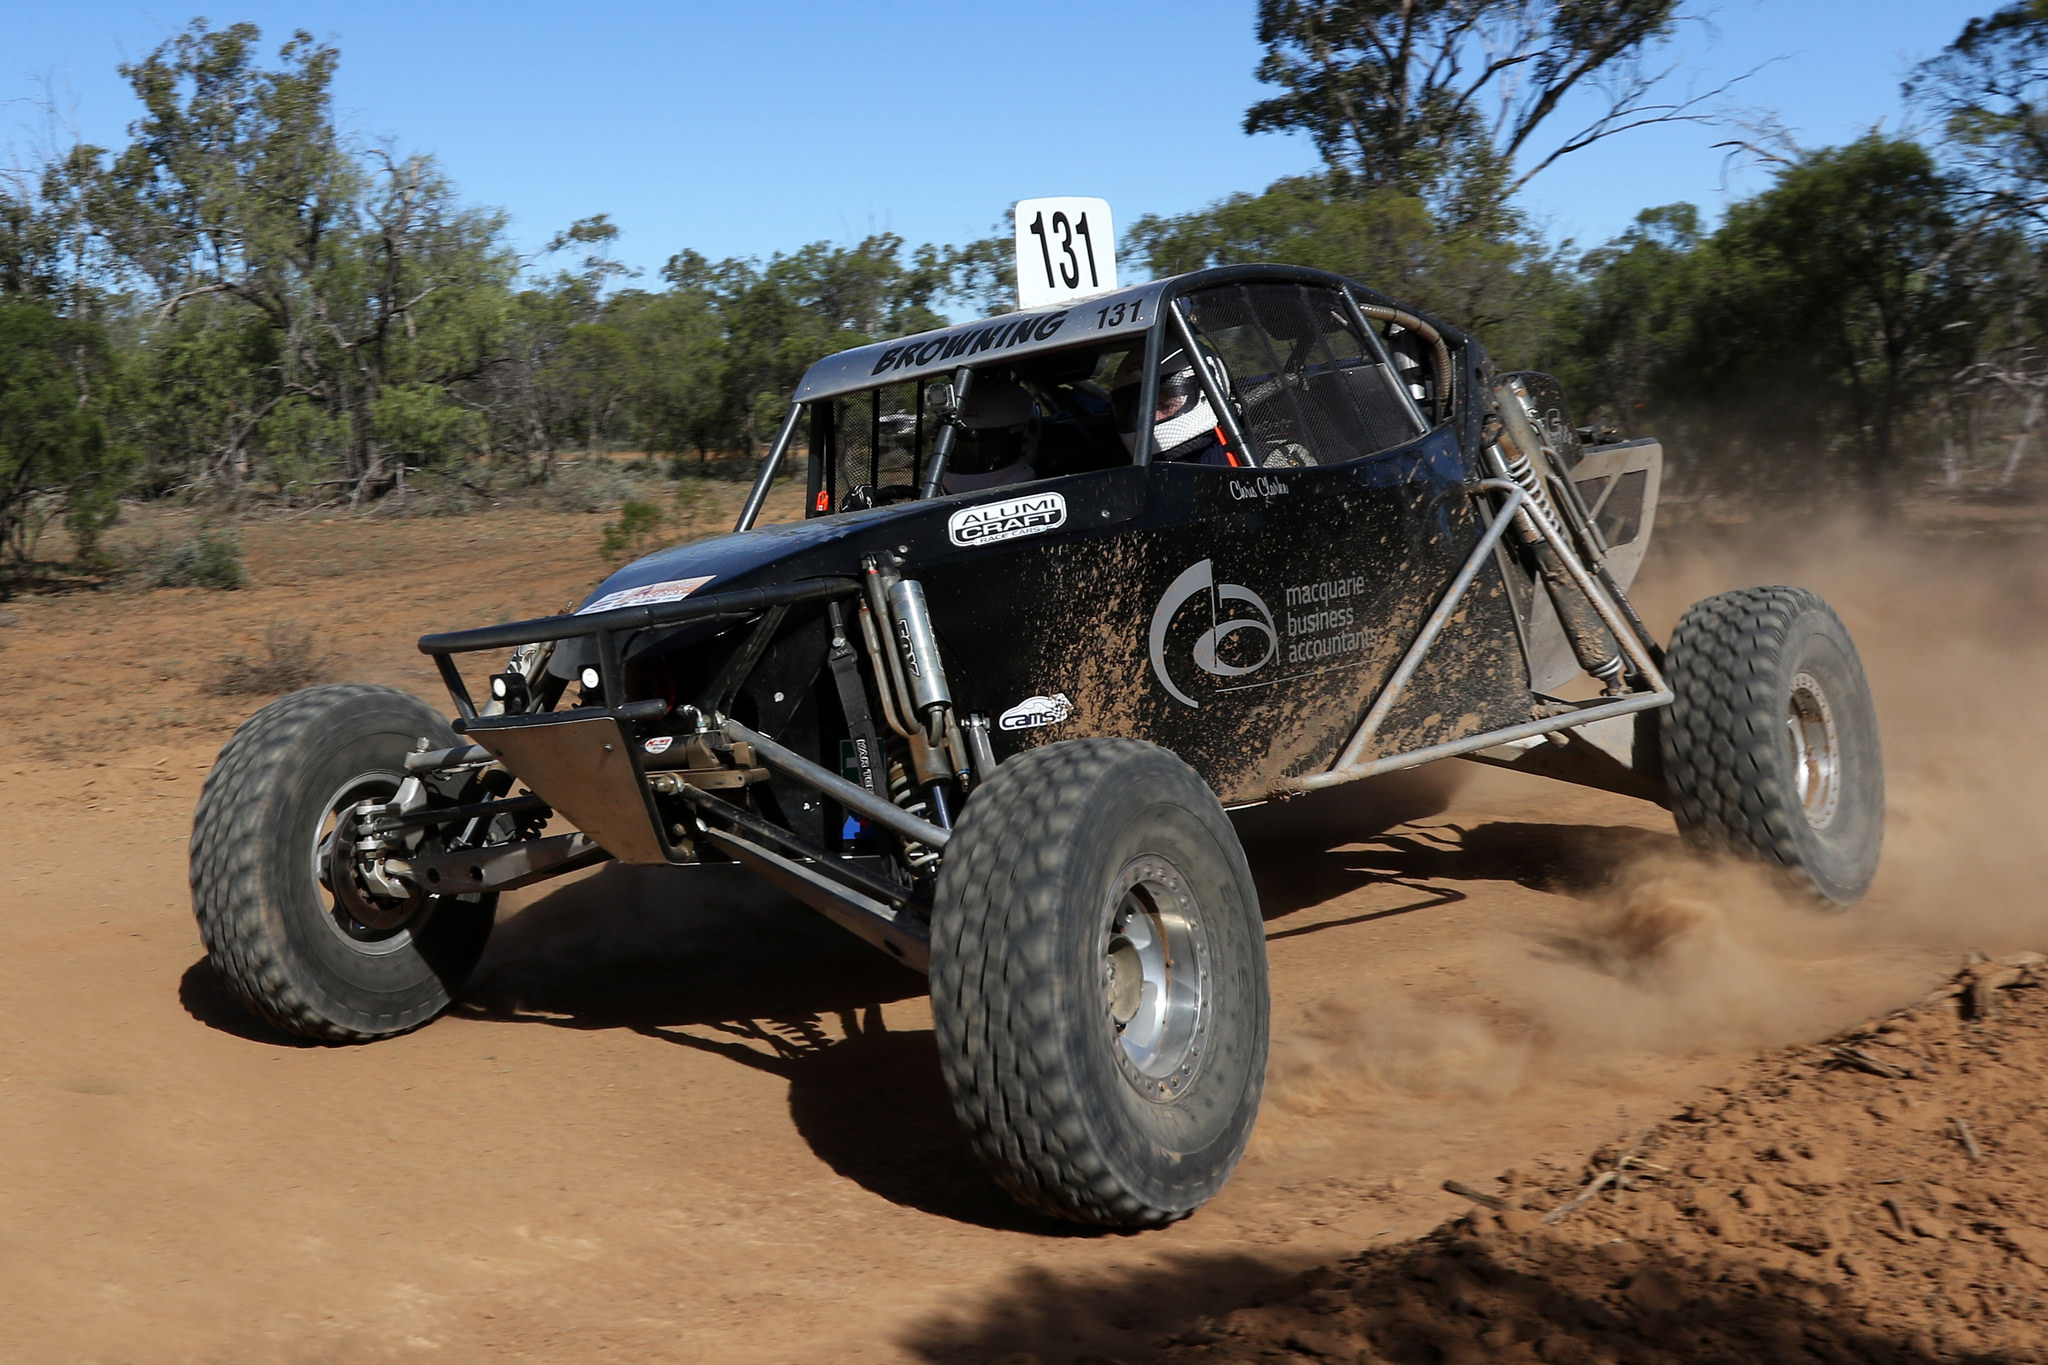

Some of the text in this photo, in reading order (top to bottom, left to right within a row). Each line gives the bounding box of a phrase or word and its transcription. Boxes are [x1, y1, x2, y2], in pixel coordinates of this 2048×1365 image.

[1030, 211, 1099, 289] 131
[870, 299, 1144, 376] BROWNING 131
[961, 511, 1056, 540] CRAFT
[962, 498, 1056, 527] ALUMI
[980, 526, 1042, 544] RACE CARS
[1286, 570, 1365, 607] macquarie
[1287, 606, 1354, 637] business
[1288, 627, 1378, 663] accountants
